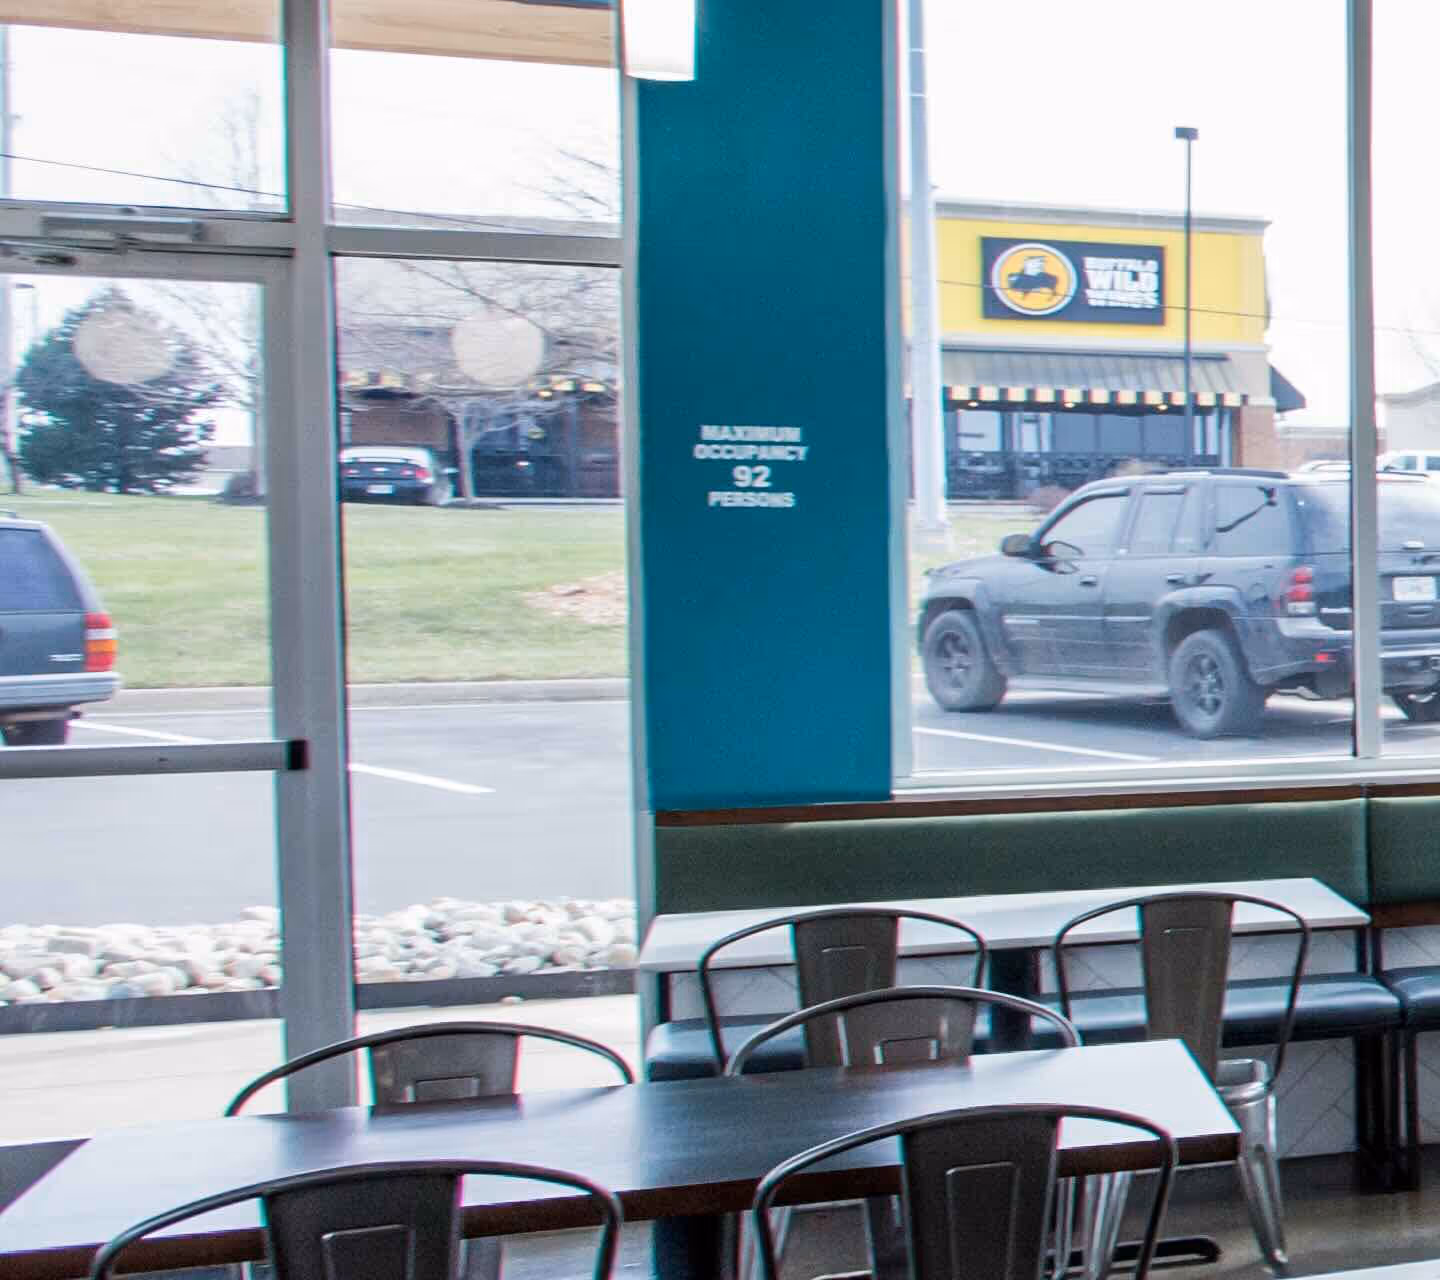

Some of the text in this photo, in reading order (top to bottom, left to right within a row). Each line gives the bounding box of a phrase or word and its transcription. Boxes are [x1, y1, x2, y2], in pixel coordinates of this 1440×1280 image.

[1087, 271, 1158, 291] WILD
[701, 425, 801, 442] MAXIMUM
[693, 444, 808, 460] OCCUPANCY
[733, 465, 771, 487] 92
[708, 491, 795, 508] PERSONS
